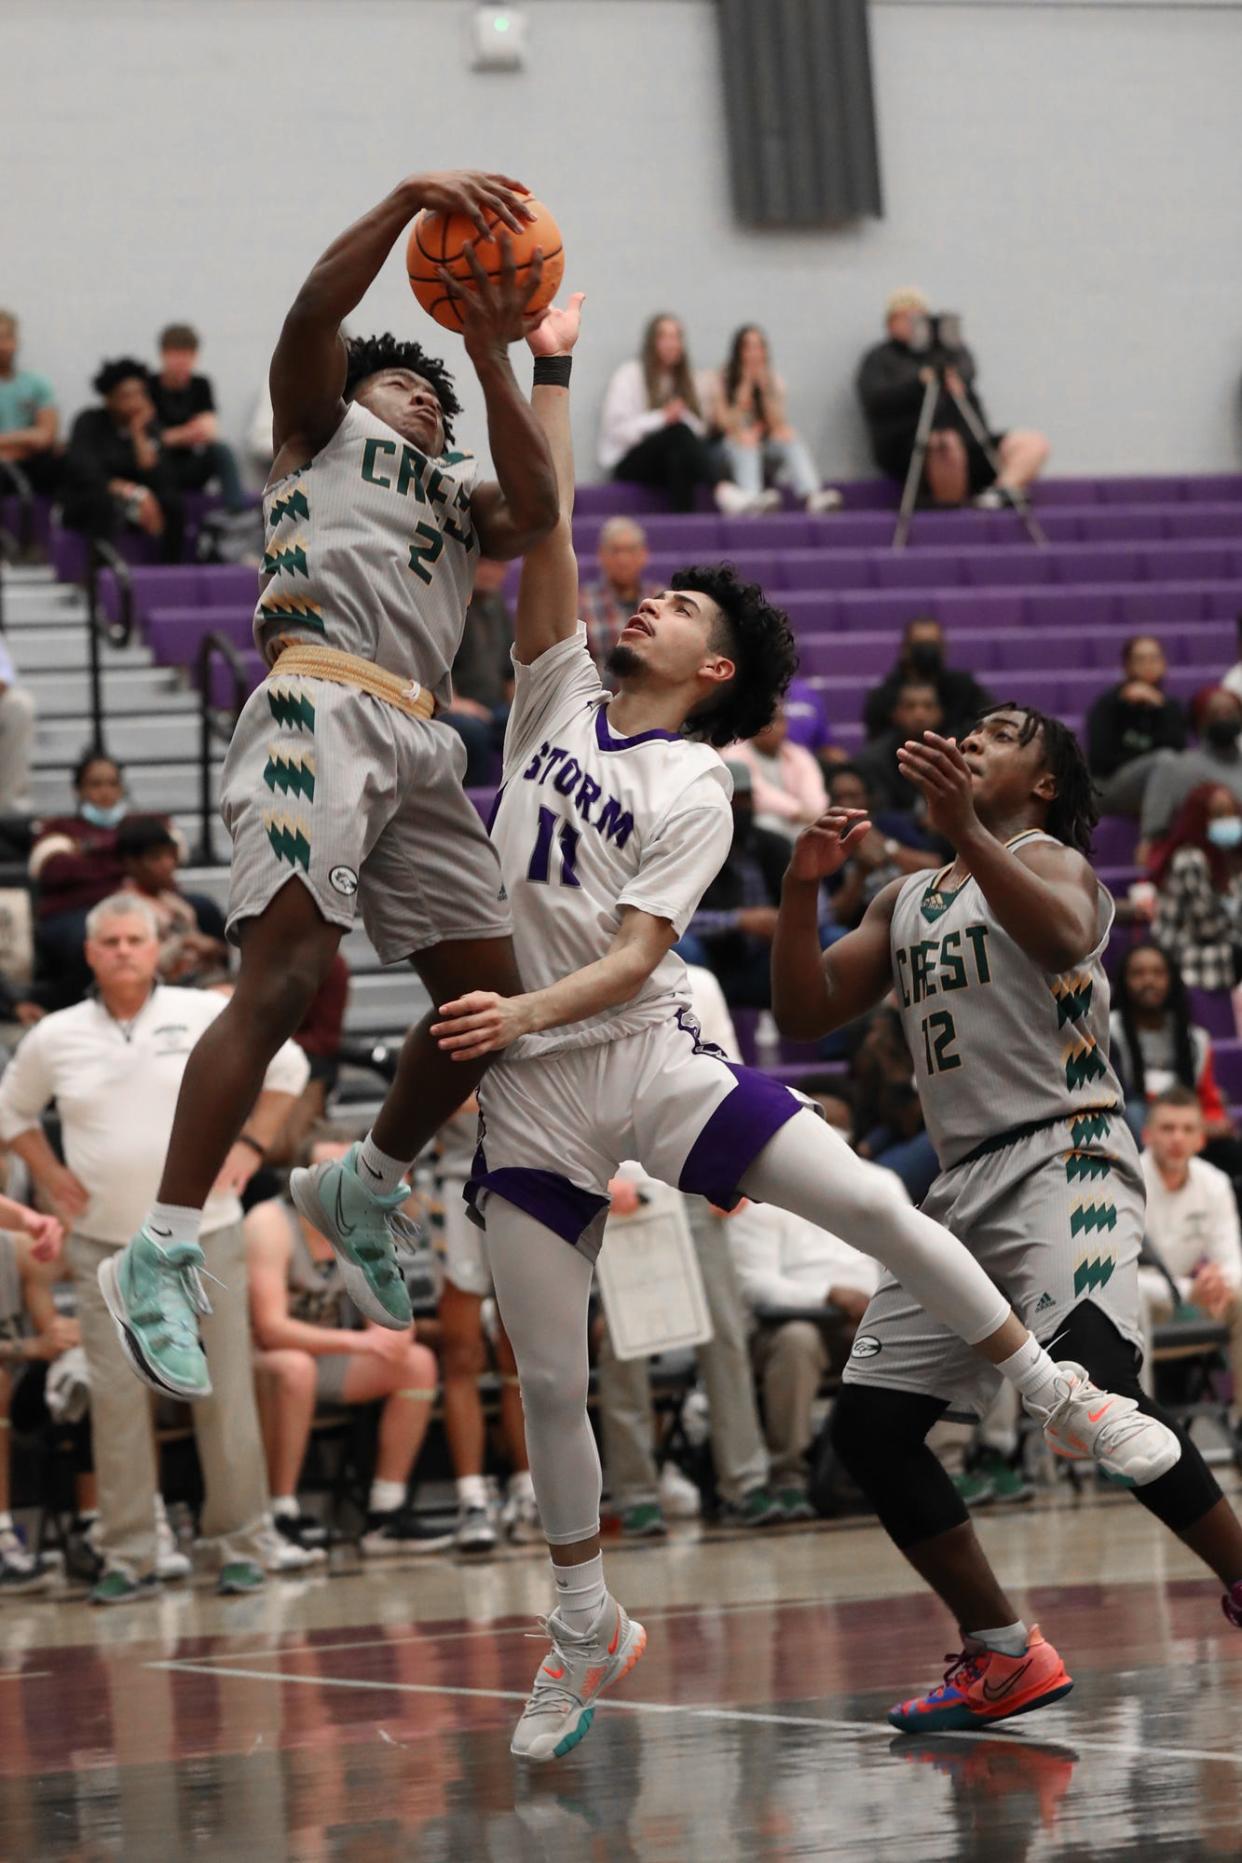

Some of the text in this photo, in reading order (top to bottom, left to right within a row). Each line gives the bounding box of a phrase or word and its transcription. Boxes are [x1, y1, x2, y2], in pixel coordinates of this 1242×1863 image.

[408, 520, 443, 586] 2
[523, 741, 634, 849] STORM
[527, 804, 581, 888] 11
[922, 1010, 961, 1075] 12
